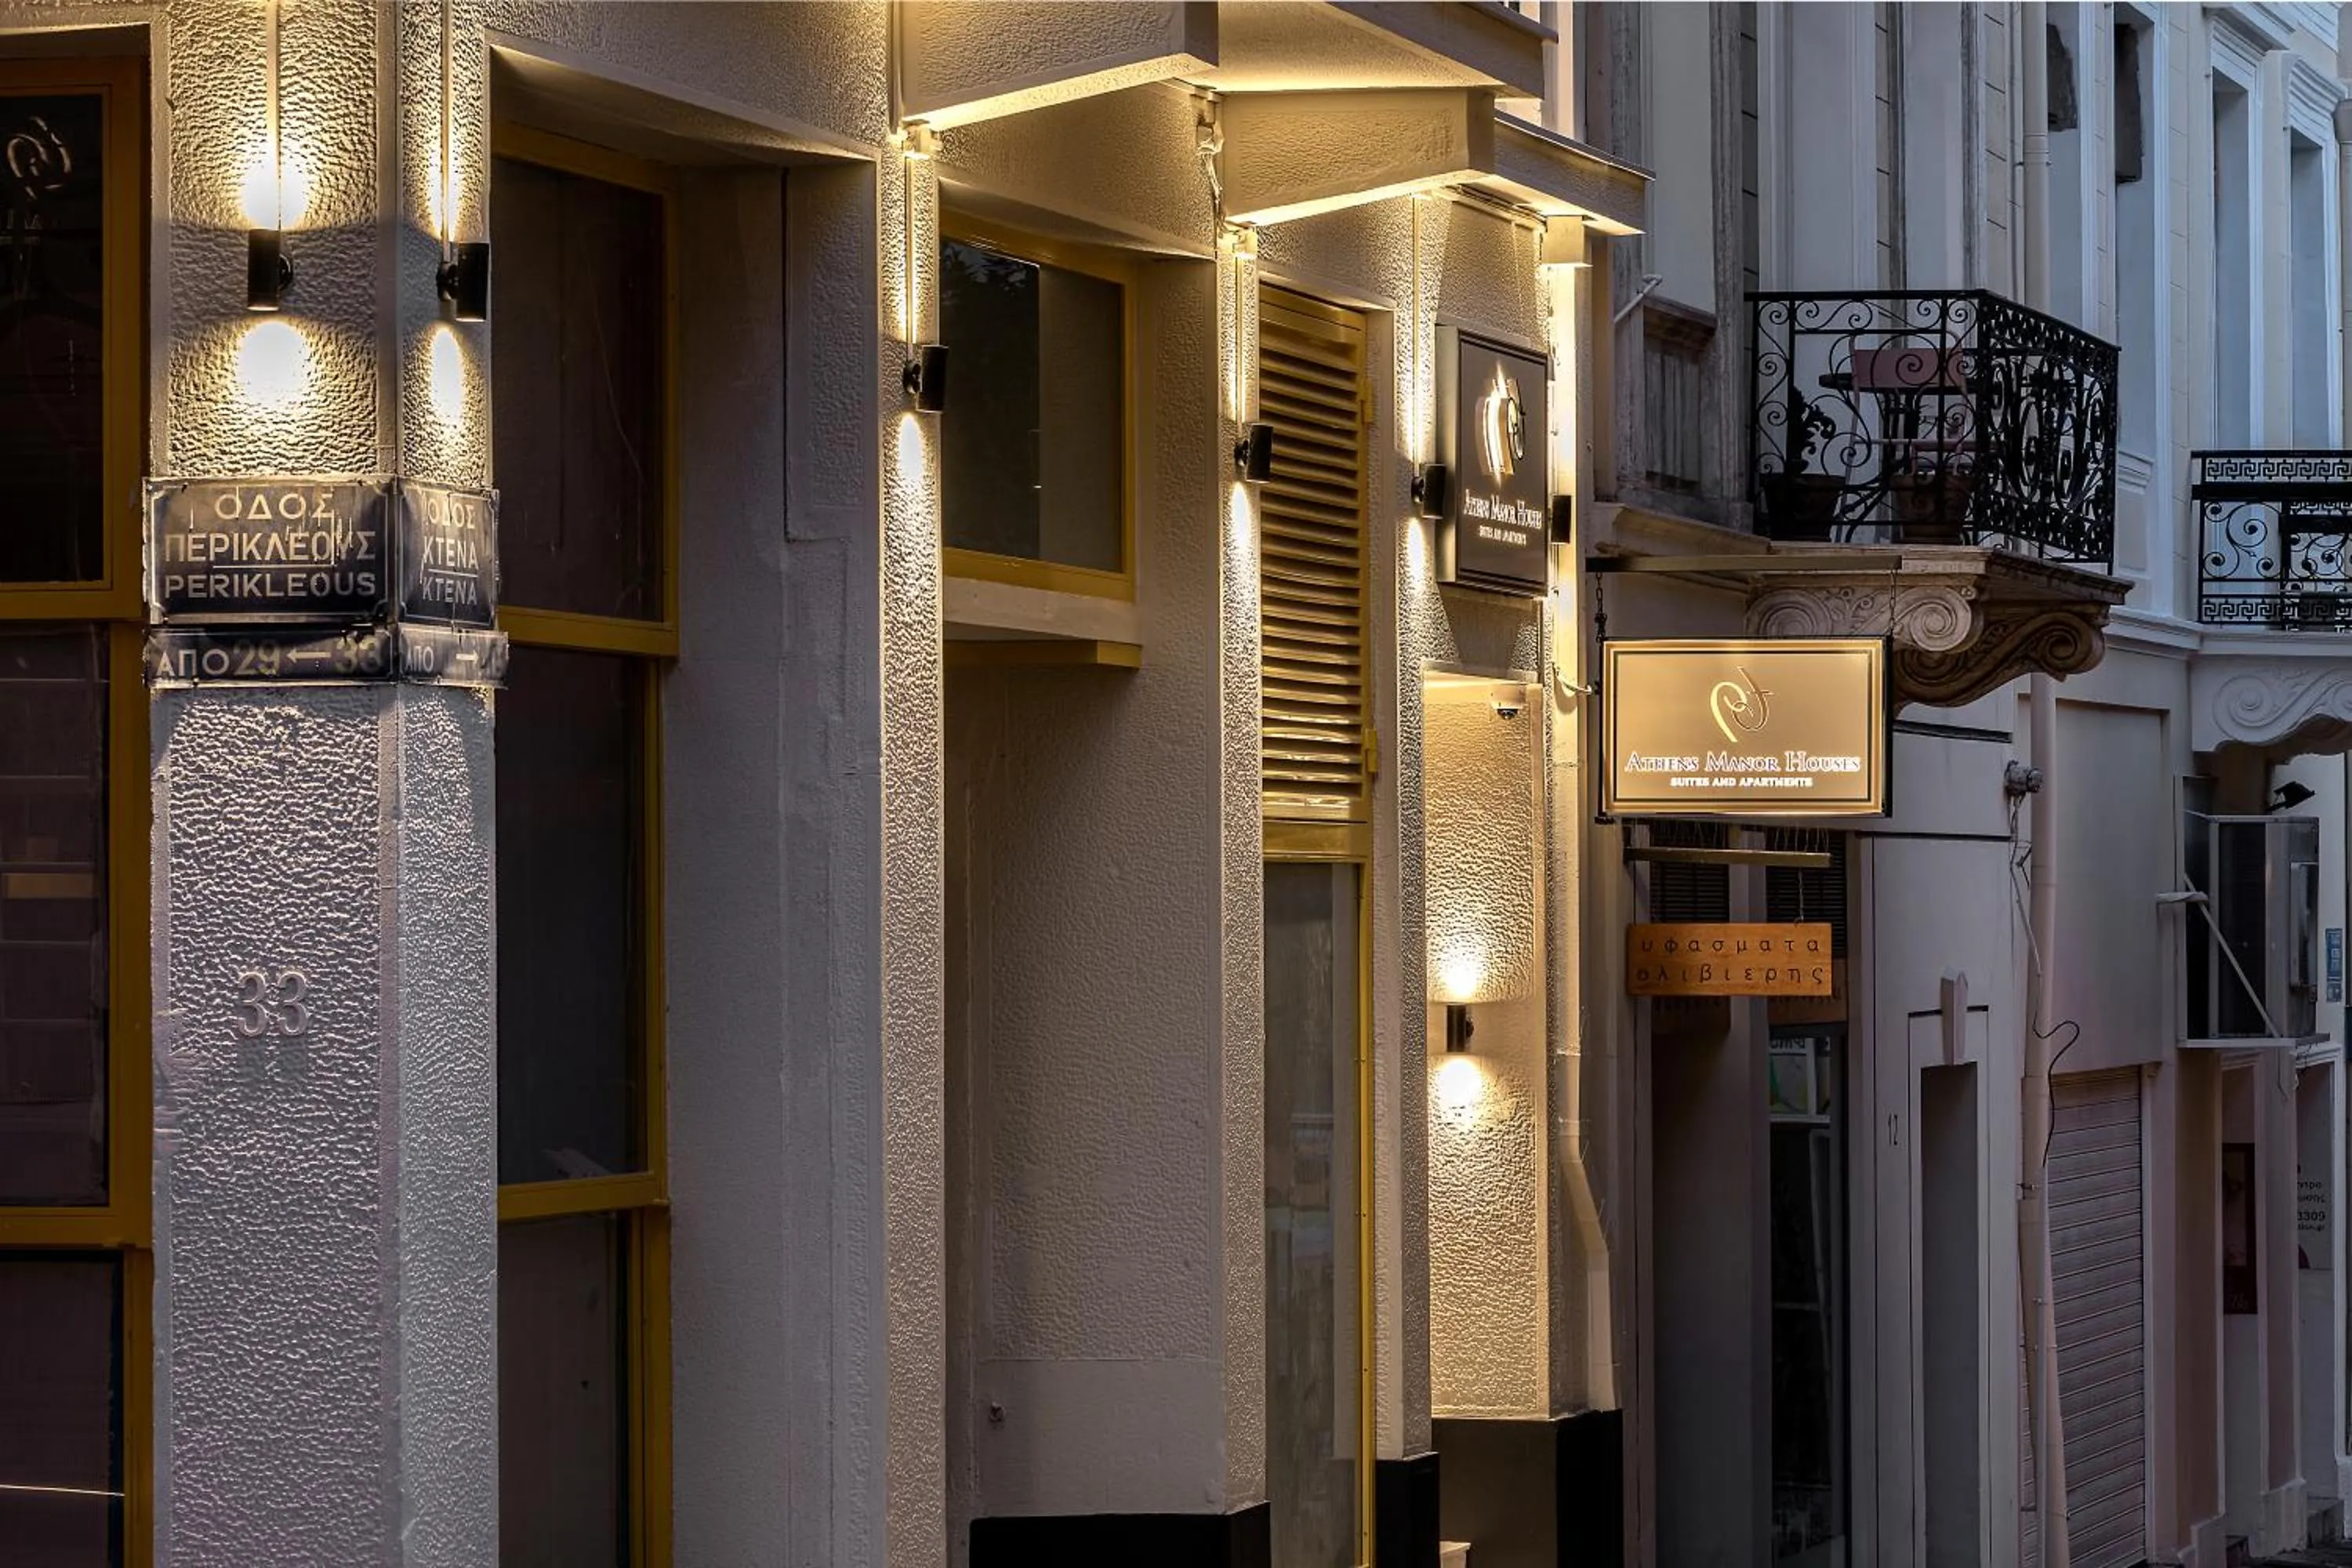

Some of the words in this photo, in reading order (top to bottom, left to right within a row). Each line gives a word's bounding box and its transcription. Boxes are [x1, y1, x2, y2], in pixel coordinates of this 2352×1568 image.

[214, 492, 335, 521] ΟΔΟΣ
[428, 498, 476, 529] ΟΔΟΣ
[165, 530, 376, 563] ΠΕΡΙΚΛΕΟΥΣ
[423, 535, 479, 570] ΚΤΕΝΑ
[165, 572, 376, 599] PERIKLEOUS
[422, 576, 478, 606] KTENA
[156, 648, 230, 677] ΑΠΟ
[233, 639, 281, 677] 29
[405, 644, 434, 673] ΑΠΟ
[1705, 750, 1780, 772] MANOR
[1670, 776, 1710, 788] SUITES
[1711, 776, 1737, 788] AND
[1739, 776, 1813, 788] APARTMENTS
[1641, 938, 1820, 954] υφασματα
[237, 971, 309, 1037] 33
